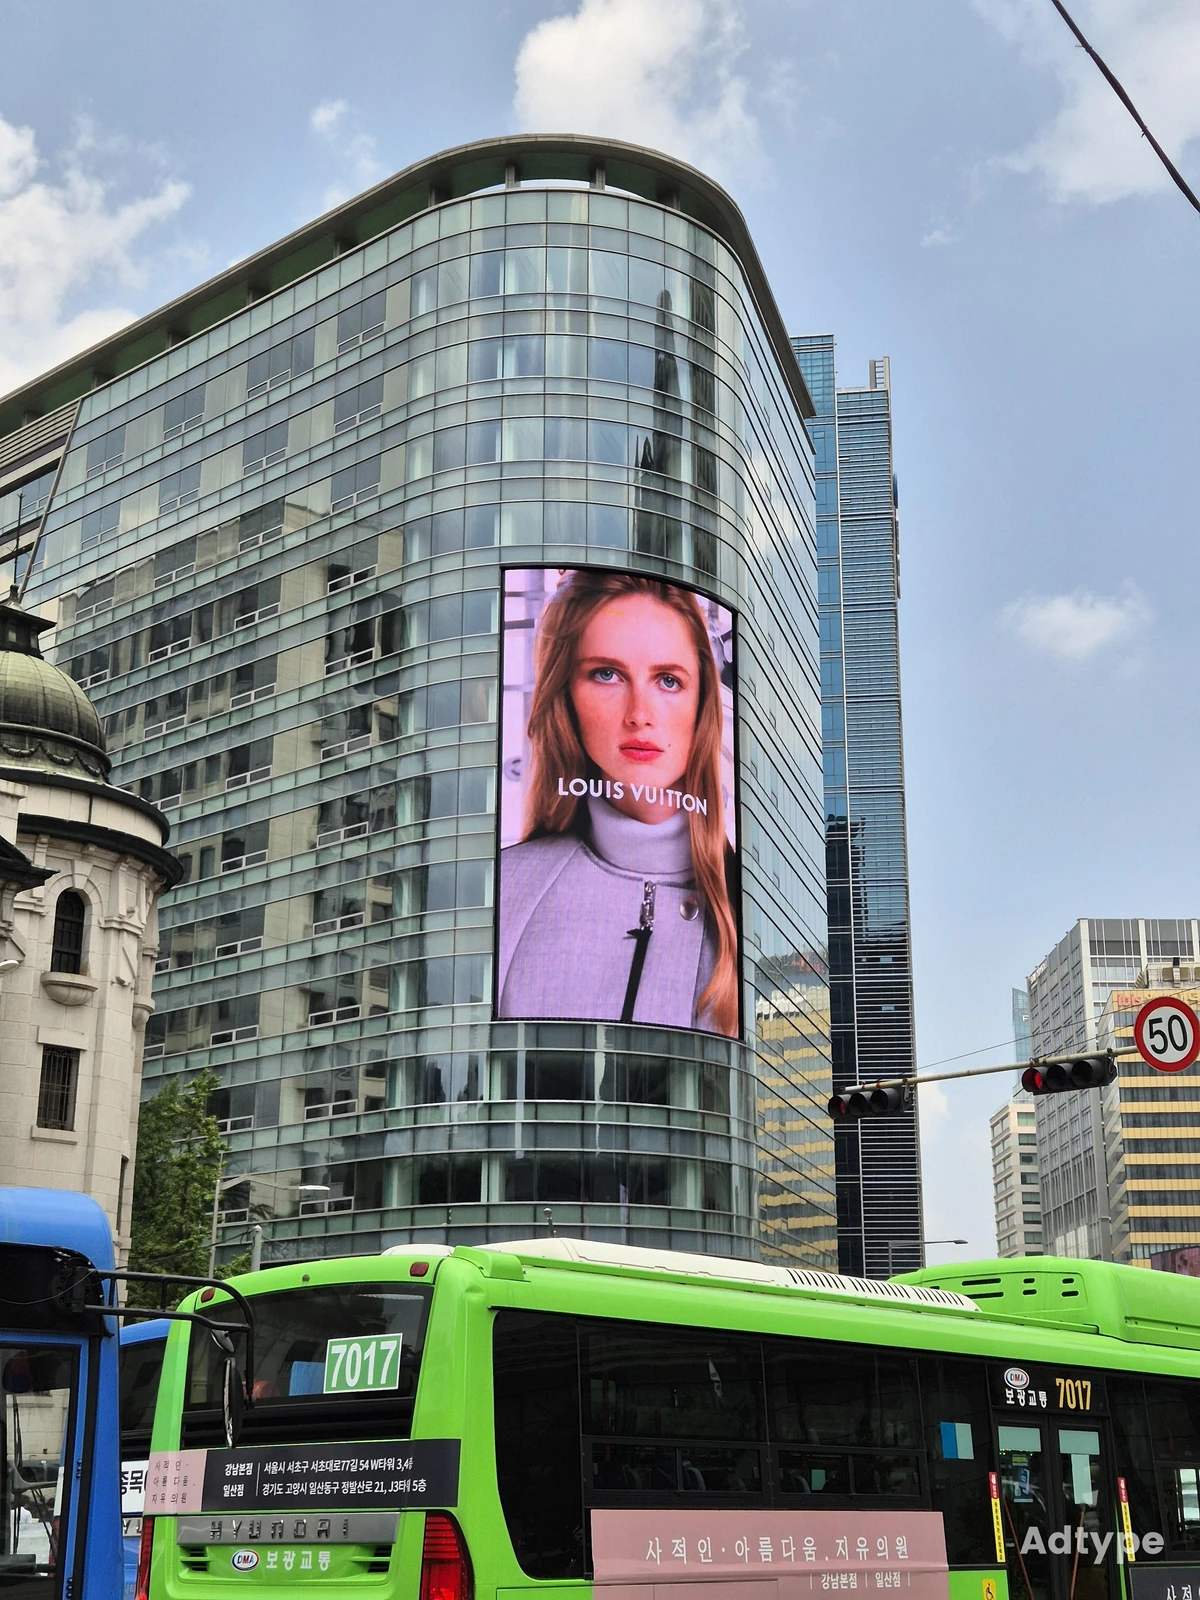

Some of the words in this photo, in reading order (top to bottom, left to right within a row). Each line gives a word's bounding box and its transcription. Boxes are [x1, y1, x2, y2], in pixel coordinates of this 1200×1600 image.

[558, 777, 624, 799] LOUIS
[630, 783, 707, 816] VUITTON
[1148, 1014, 1188, 1054] 50
[331, 1340, 397, 1388] 7017
[1005, 1388, 1047, 1408] 보광교통
[1055, 1377, 1091, 1411] 7017
[224, 1462, 253, 1476] 강남본점
[264, 1461, 286, 1474] 서울시
[287, 1461, 309, 1473] 서초구
[310, 1459, 358, 1473] 서초대로77길
[359, 1460, 369, 1471] 54
[371, 1458, 395, 1471] W타워
[121, 1469, 148, 1496] 종목
[223, 1484, 244, 1497] 일산점
[262, 1483, 283, 1495] 경기도
[284, 1482, 307, 1495] 고양시
[309, 1481, 340, 1495] 일산동구
[341, 1480, 373, 1494] 정발산로
[374, 1481, 387, 1494] 21,
[412, 1479, 427, 1492] 5층
[151, 1492, 187, 1504] 지유의원
[209, 1518, 349, 1540] HYUNDAI
[836, 1535, 909, 1560] 지유의원
[266, 1551, 331, 1571] 보광교통
[821, 1573, 858, 1590] 강남본점
[875, 1571, 901, 1588] 일산점
[1166, 1584, 1200, 1600] 사적
